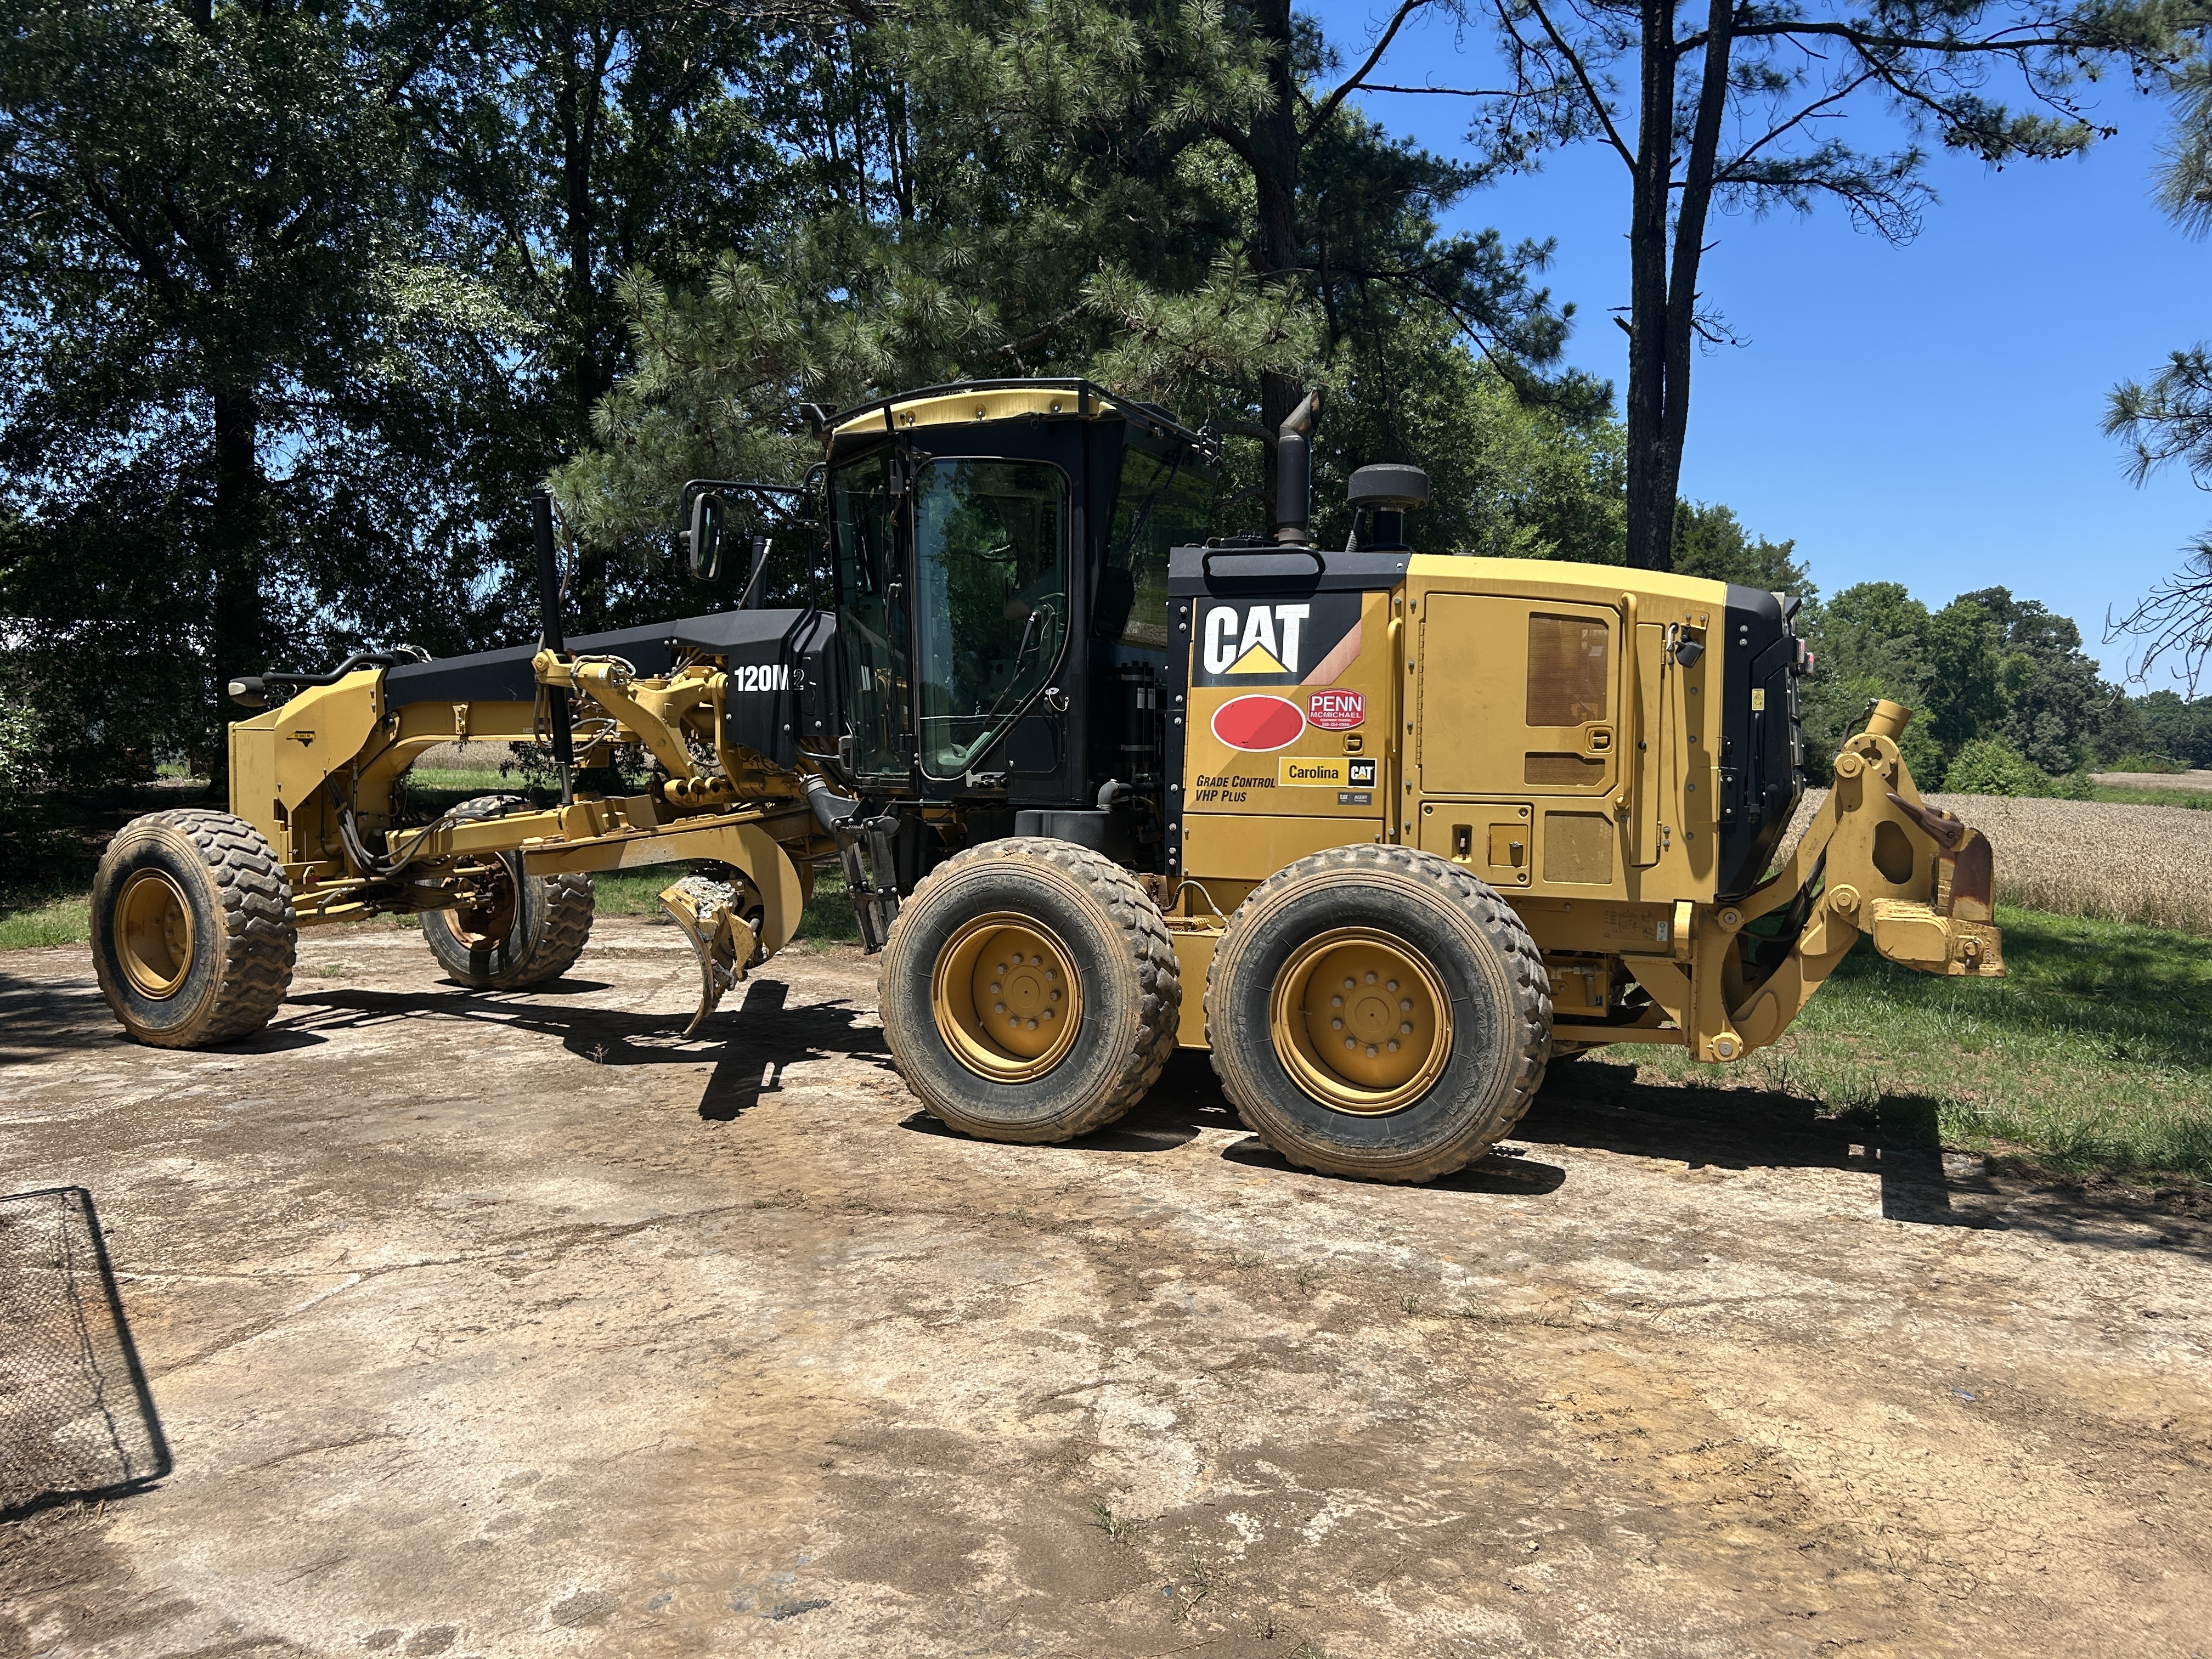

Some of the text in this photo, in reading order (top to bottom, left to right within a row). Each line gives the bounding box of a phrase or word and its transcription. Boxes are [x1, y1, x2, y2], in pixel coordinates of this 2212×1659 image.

[1204, 604, 1310, 674] CAT
[1311, 696, 1362, 712] PENN
[1289, 765, 1374, 780] Carolina CAT
[1196, 775, 1276, 788] GRADE CONTROL
[1195, 789, 1246, 802] VHP PLUS
[1445, 998, 1488, 1116] MAXAM
